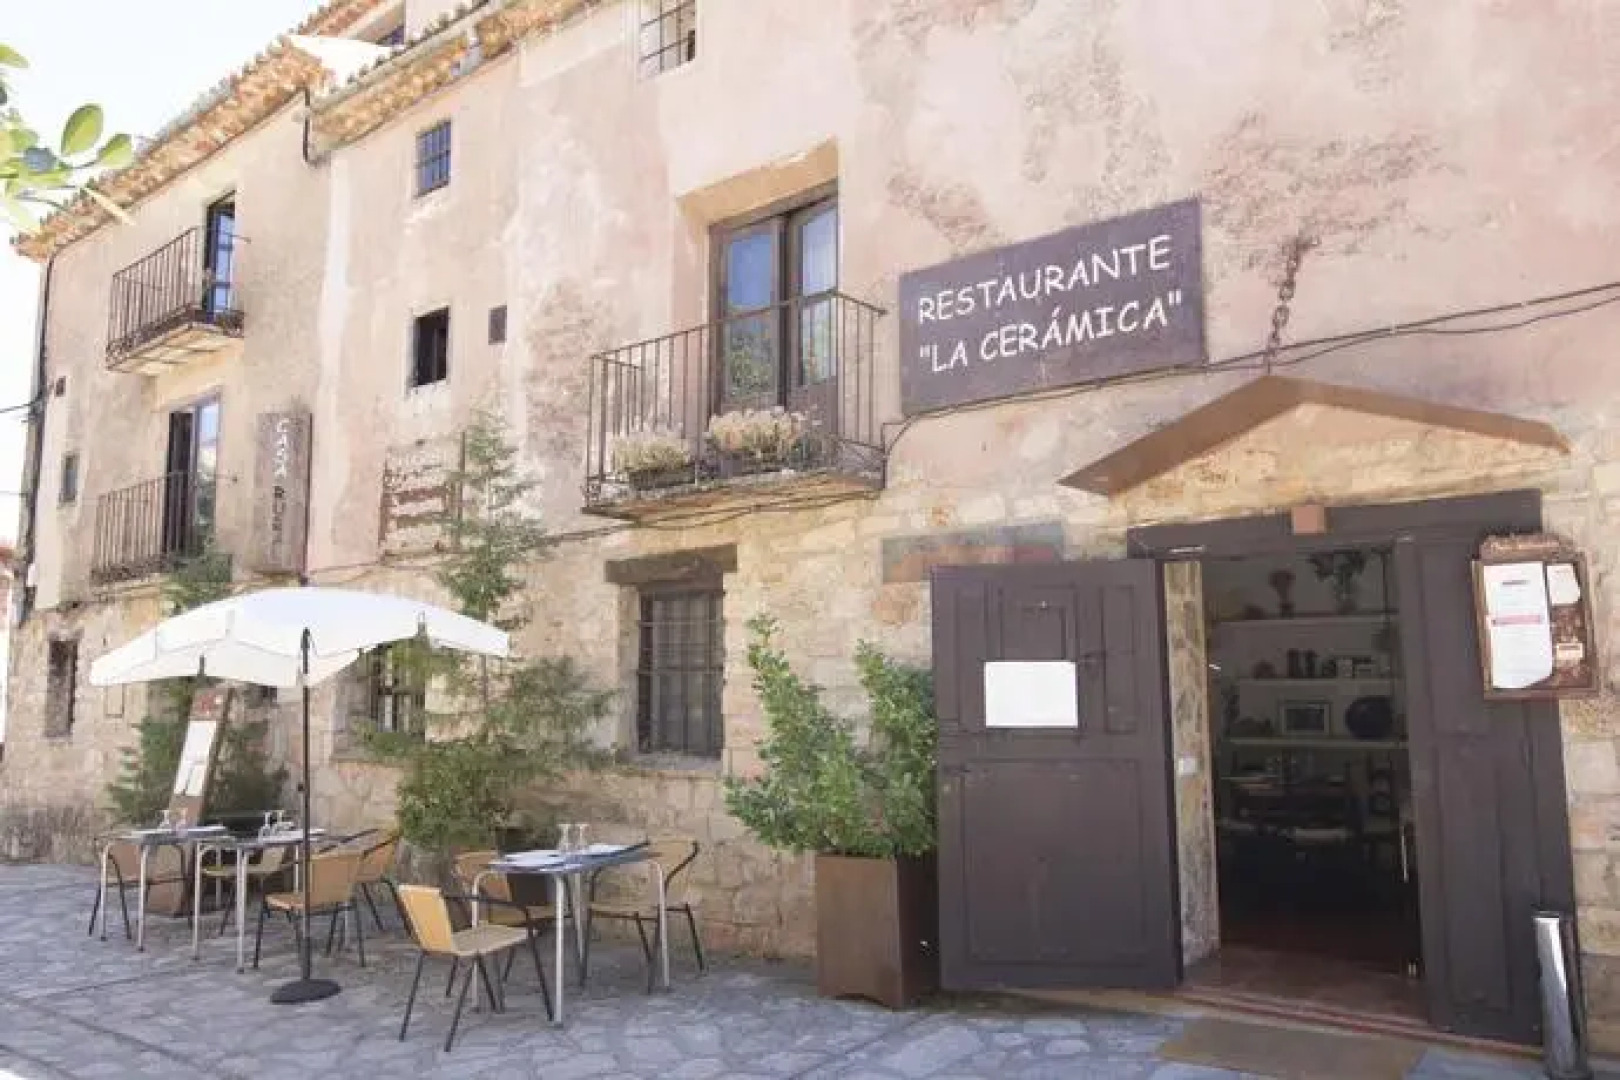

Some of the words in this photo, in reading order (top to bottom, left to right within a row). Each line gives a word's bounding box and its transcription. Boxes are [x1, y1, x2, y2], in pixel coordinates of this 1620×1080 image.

[919, 234, 1172, 324] RESTAURANTE
[919, 340, 968, 373] "LA
[980, 289, 1183, 361] CERÁMICA"
